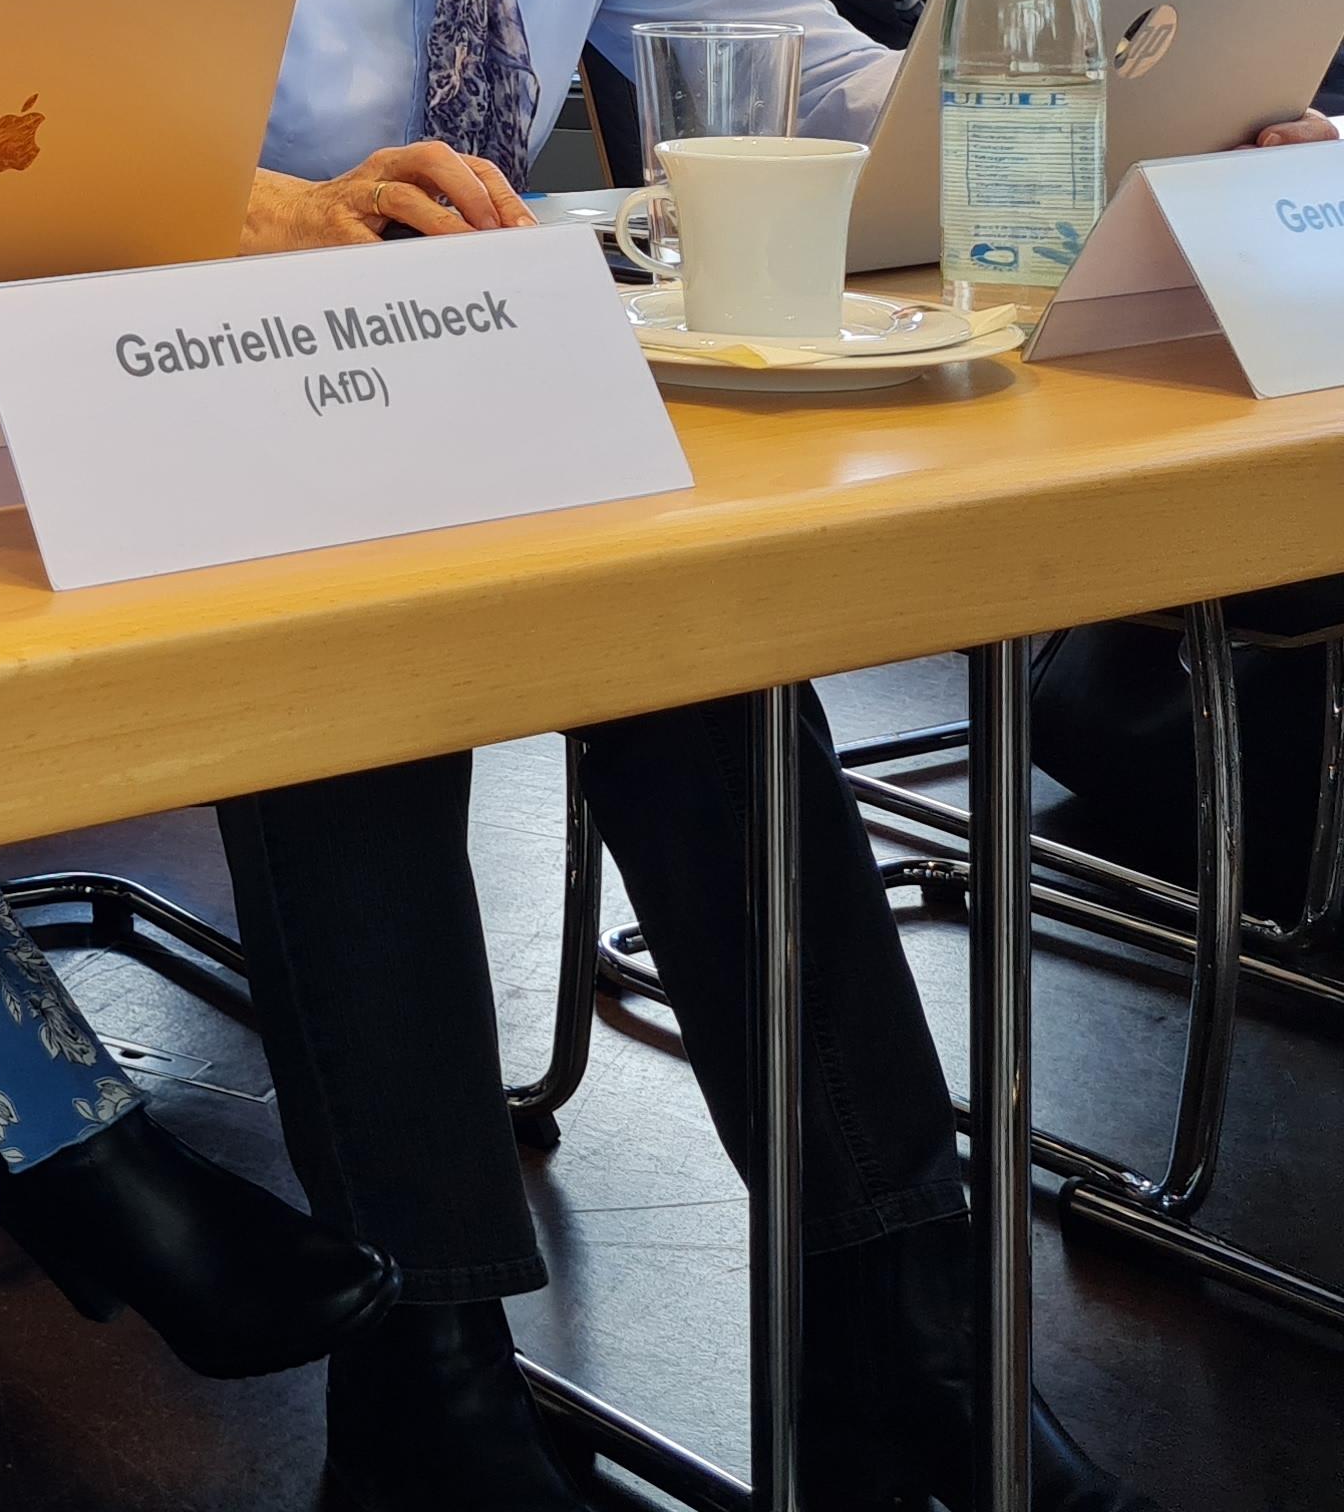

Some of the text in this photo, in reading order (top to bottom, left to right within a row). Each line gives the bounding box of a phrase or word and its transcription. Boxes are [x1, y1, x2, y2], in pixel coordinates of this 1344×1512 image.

[116, 291, 518, 377] Gabrielle Mailbeck
[304, 367, 390, 416] (AfD)
